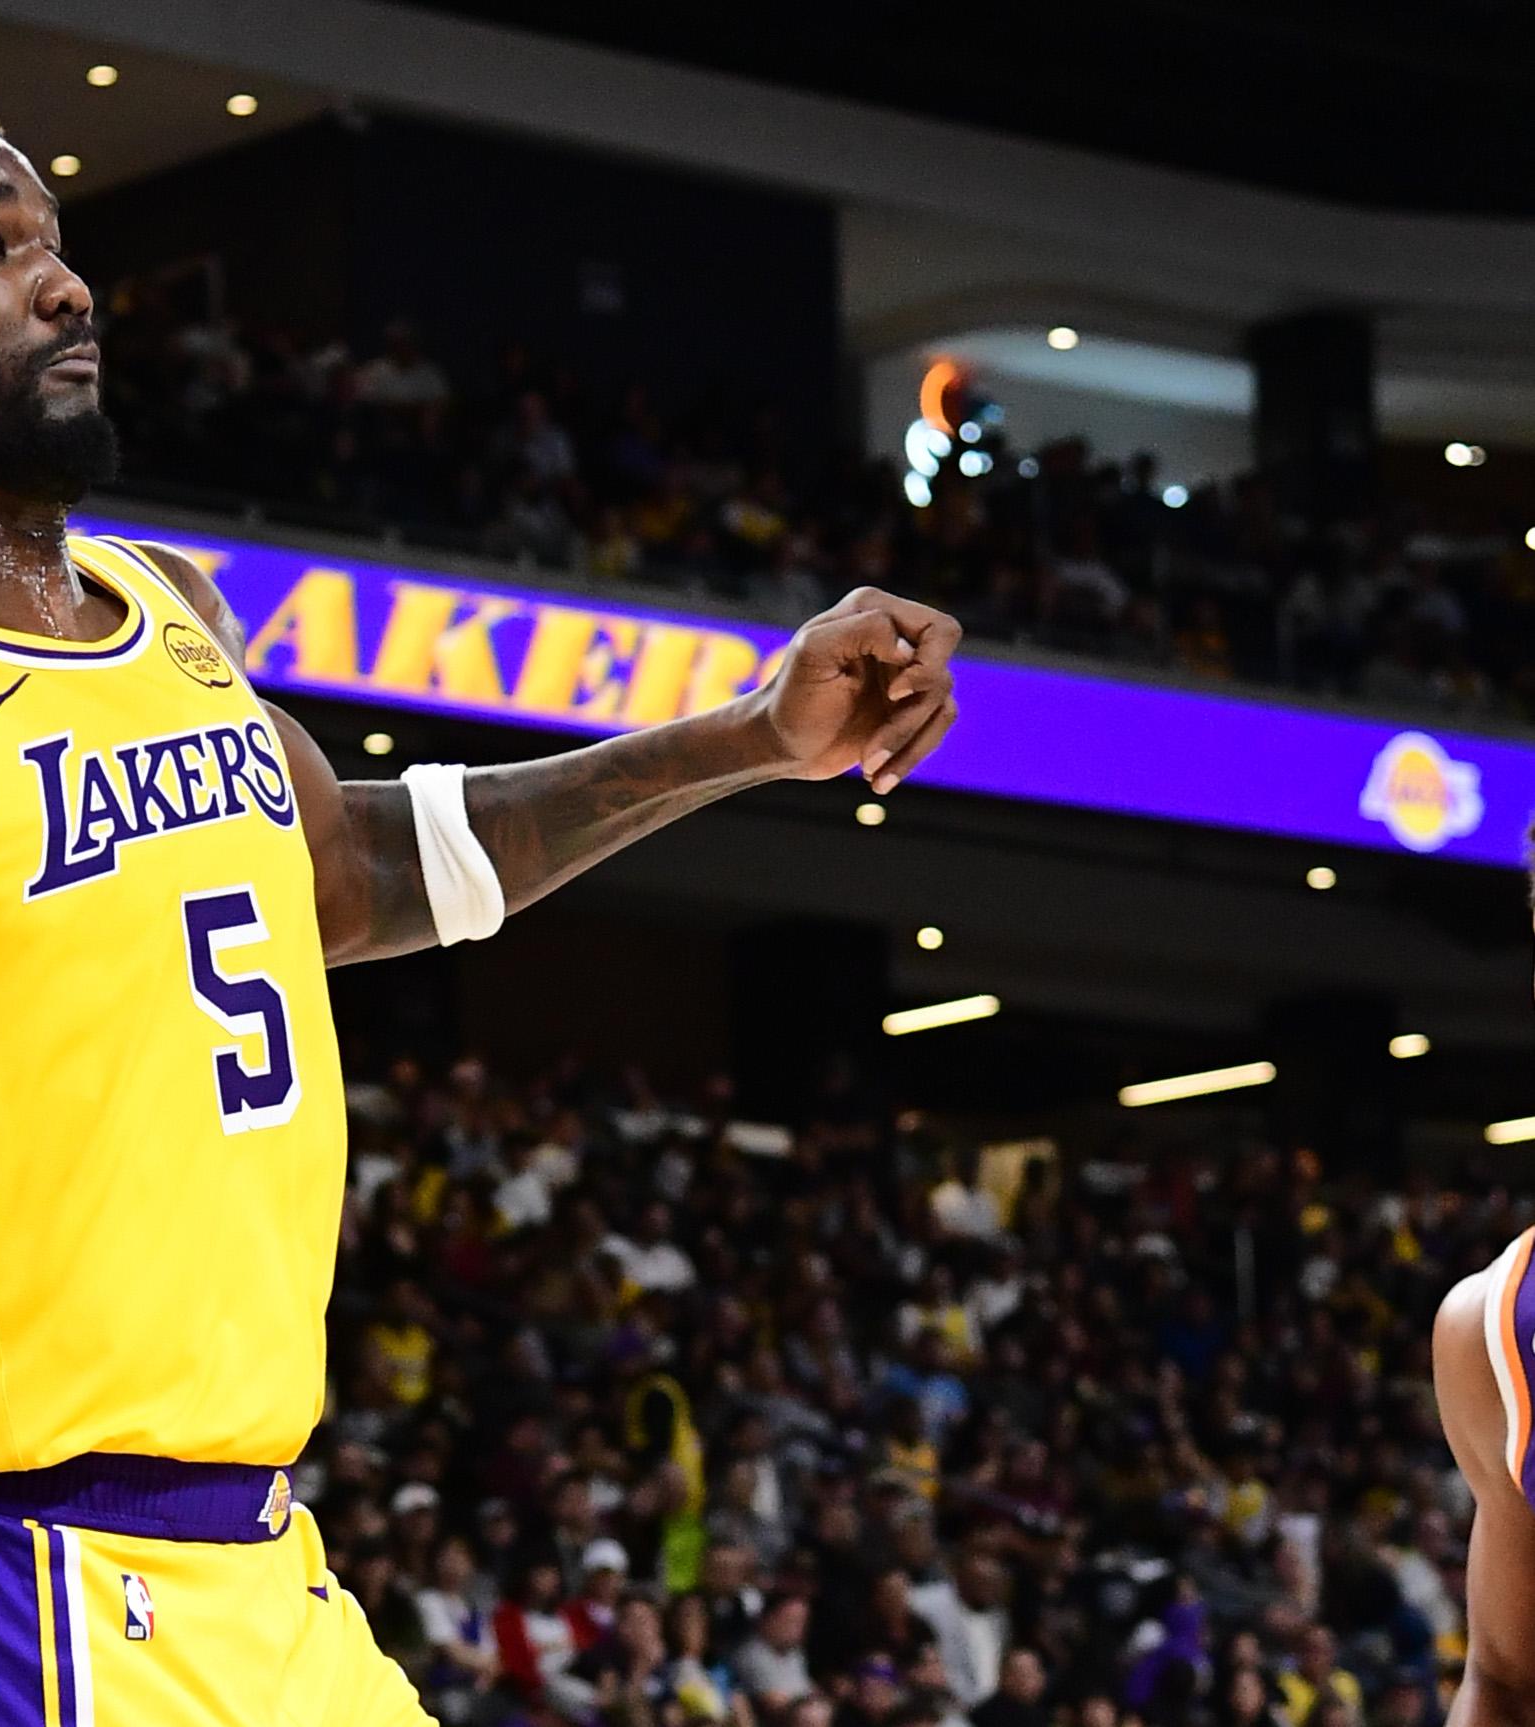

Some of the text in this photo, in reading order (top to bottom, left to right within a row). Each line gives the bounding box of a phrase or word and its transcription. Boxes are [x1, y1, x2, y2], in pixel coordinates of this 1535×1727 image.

[178, 547, 788, 727] AKER
[20, 722, 294, 902] LAKERS
[181, 885, 302, 1135] 5
